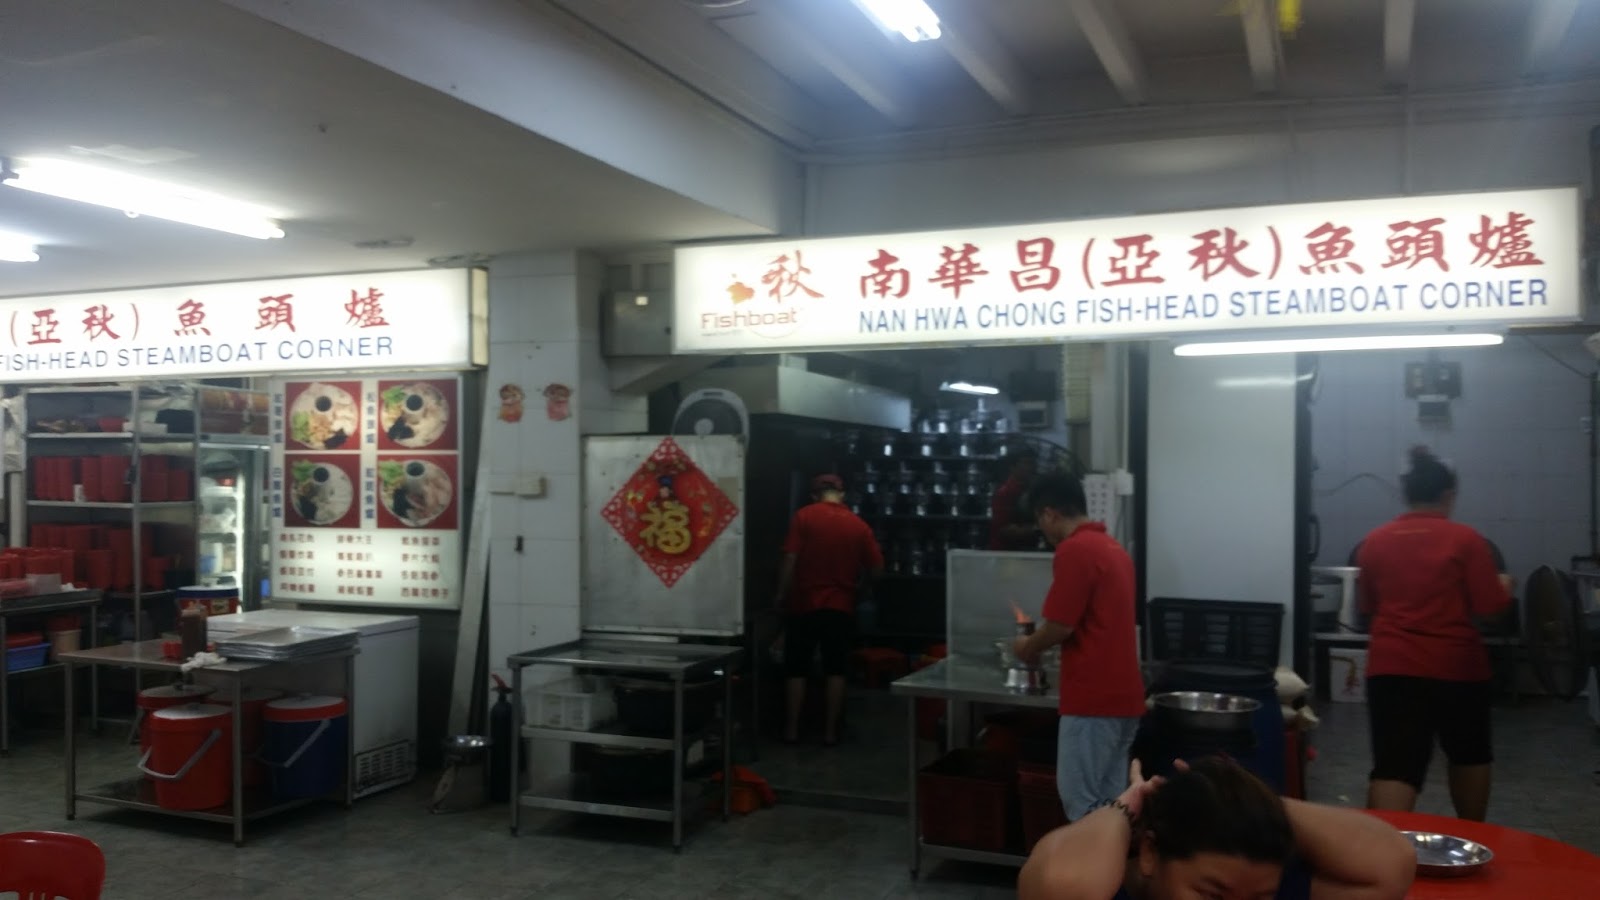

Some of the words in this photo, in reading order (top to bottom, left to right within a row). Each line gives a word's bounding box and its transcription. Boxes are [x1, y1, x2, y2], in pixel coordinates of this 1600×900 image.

[701, 308, 798, 329] Fishboat
[859, 309, 907, 333] NAN
[915, 306, 968, 331] HWA
[977, 301, 1066, 328] CHONG
[1076, 293, 1219, 324] FISH-HEAD
[1229, 284, 1408, 317] STEAMBOAT
[1420, 279, 1548, 310] CORNER
[117, 342, 268, 367] STEAMBOAT
[278, 336, 393, 359] CORNER
[639, 500, 692, 554] 福
